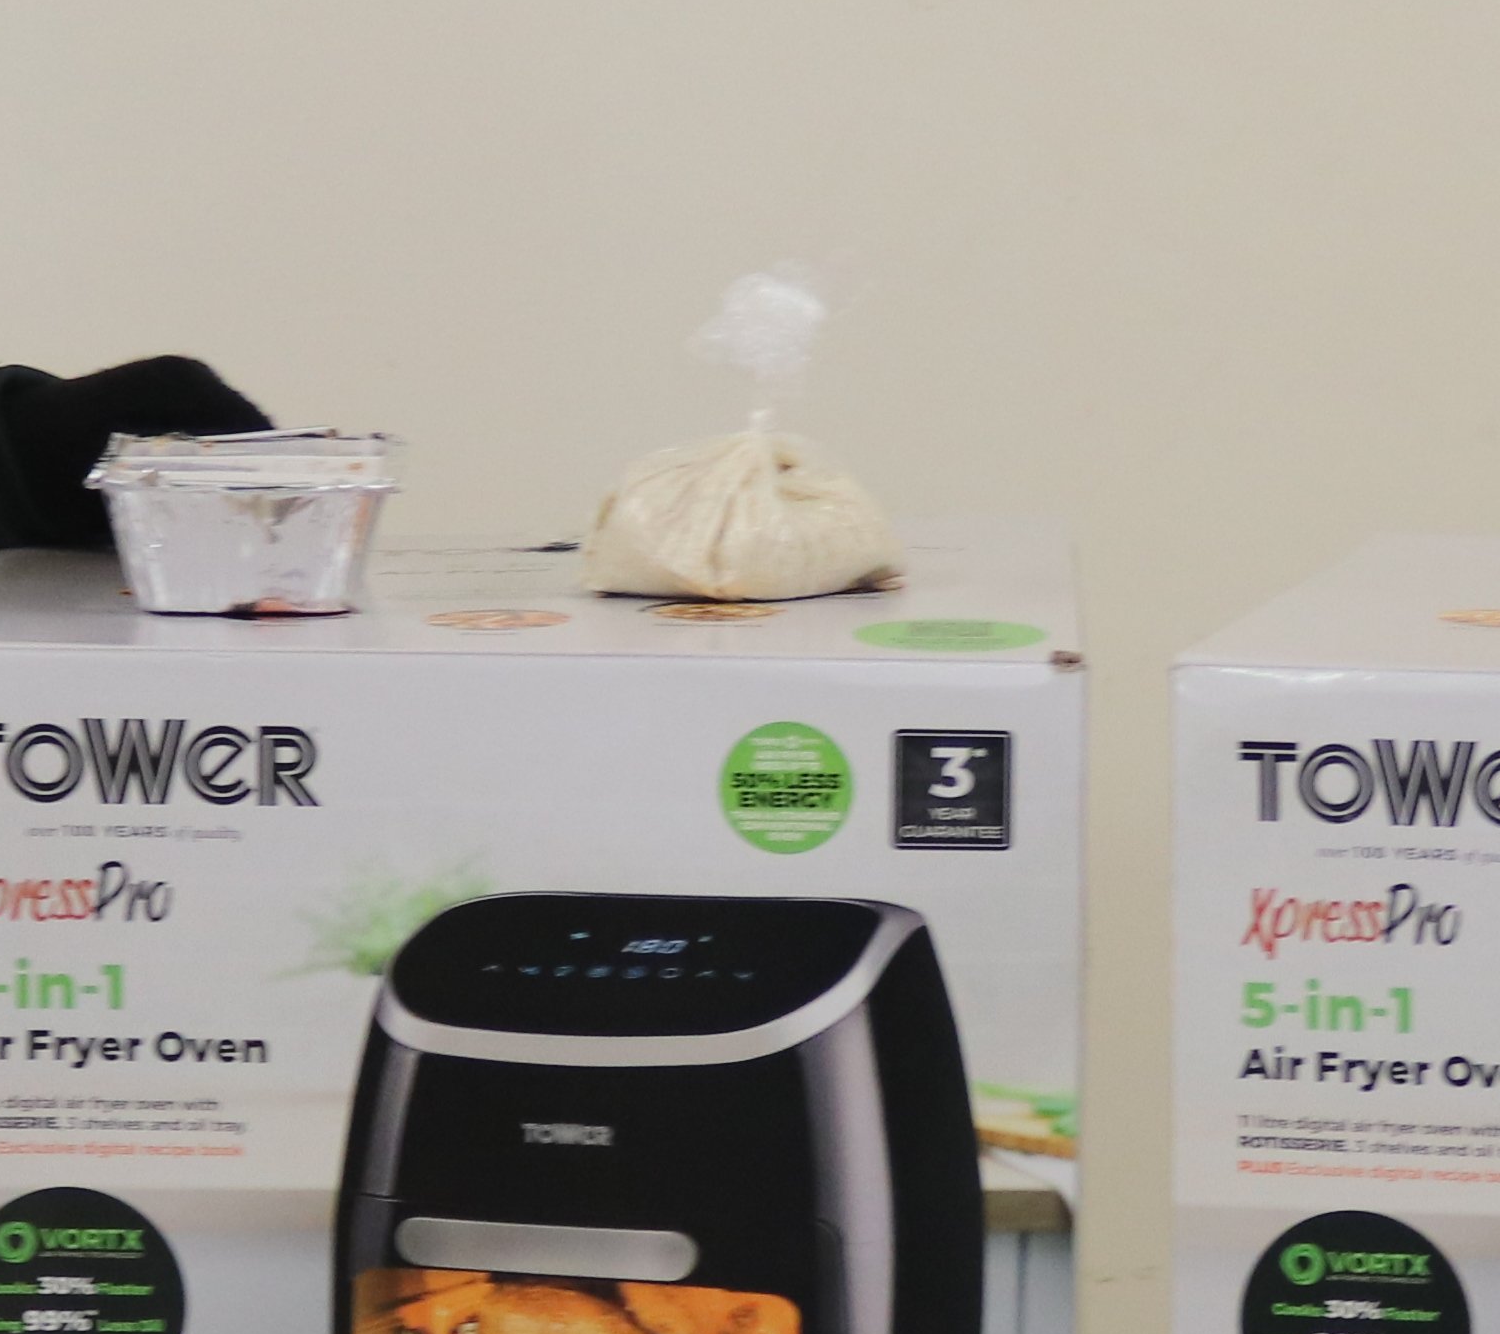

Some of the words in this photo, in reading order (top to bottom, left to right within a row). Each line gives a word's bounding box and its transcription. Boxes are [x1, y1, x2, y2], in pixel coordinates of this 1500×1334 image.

[737, 791, 832, 808] ENERGY
[927, 807, 977, 820] YEAR
[899, 825, 1003, 838] GUARANTEE
[1240, 883, 1462, 960] XpressPro
[1240, 978, 1414, 1034] 5-in-1
[26, 1030, 143, 1068] Fryer
[156, 1031, 268, 1062] Oven
[1238, 1046, 1304, 1080] Air
[1316, 1051, 1431, 1091] Fryer
[38, 1228, 145, 1250] VORTX
[1326, 1251, 1431, 1276] VORTX
